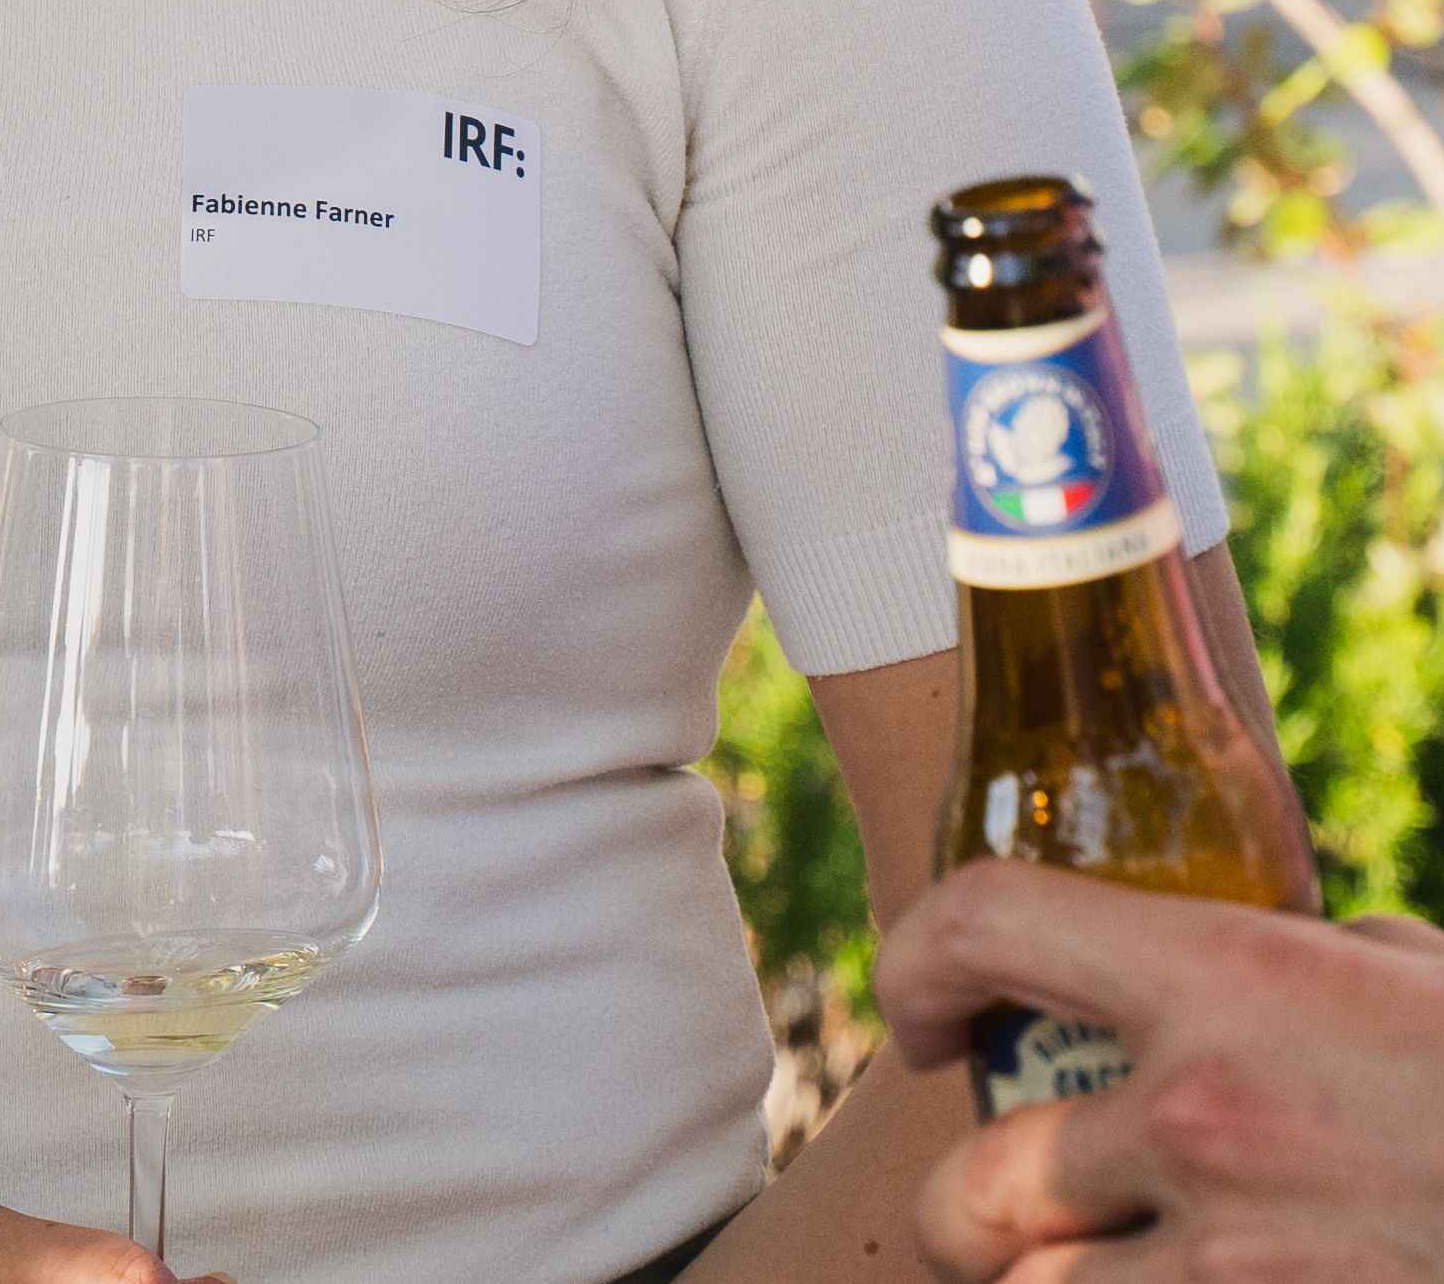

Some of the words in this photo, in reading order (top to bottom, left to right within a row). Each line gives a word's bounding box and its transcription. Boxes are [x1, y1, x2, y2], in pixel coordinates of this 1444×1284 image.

[443, 110, 525, 179] IRF:
[191, 193, 308, 219] Fabienne
[315, 199, 395, 229] Farner
[190, 228, 216, 243] IRF
